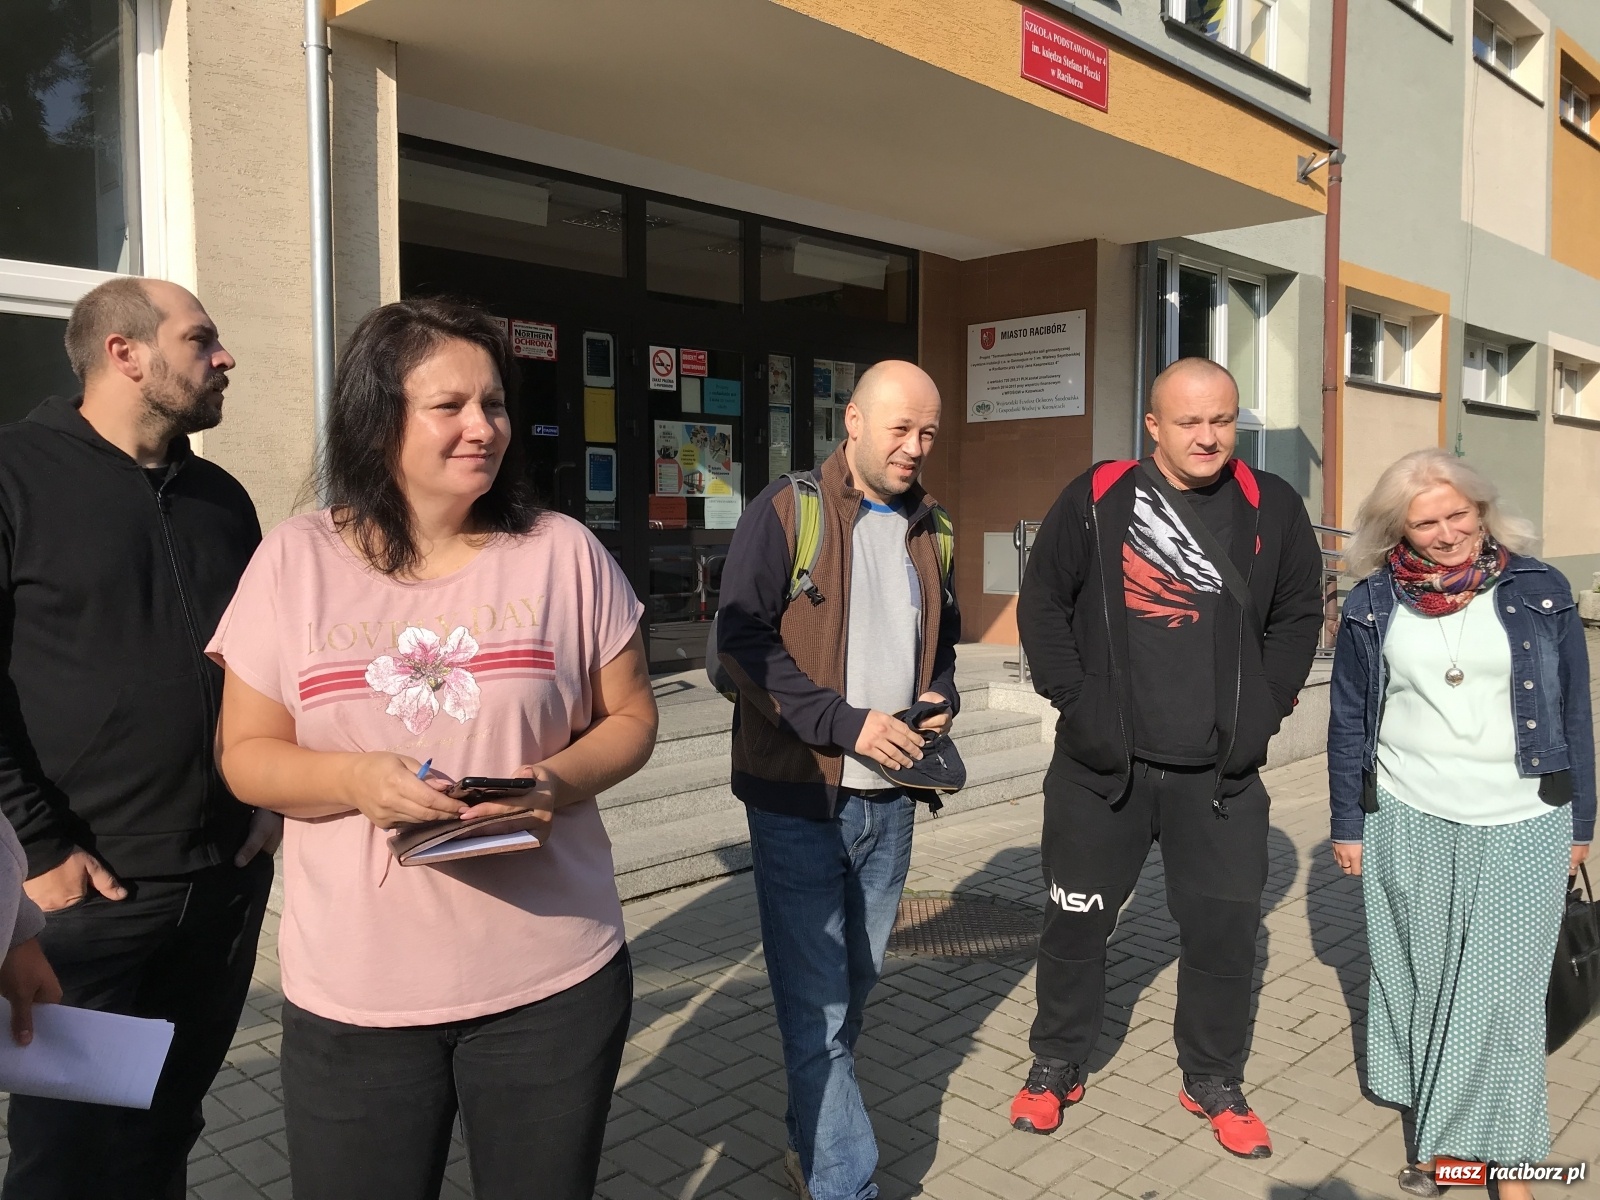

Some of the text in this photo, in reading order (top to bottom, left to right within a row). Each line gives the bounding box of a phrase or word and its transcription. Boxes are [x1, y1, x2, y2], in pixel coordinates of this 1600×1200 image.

[1025, 20, 1052, 40] SZKOŁA
[1054, 34, 1096, 62] PODSTAWOWA
[1102, 58, 1106, 66] 4
[1032, 41, 1100, 82] im. księdza Stefana Pieczki
[1051, 69, 1083, 89] w Raciborzu
[515, 338, 552, 348] OCHRONA
[1000, 323, 1066, 340] MIASTO RACIBÓRZ
[307, 594, 545, 656] LOVEY DAY
